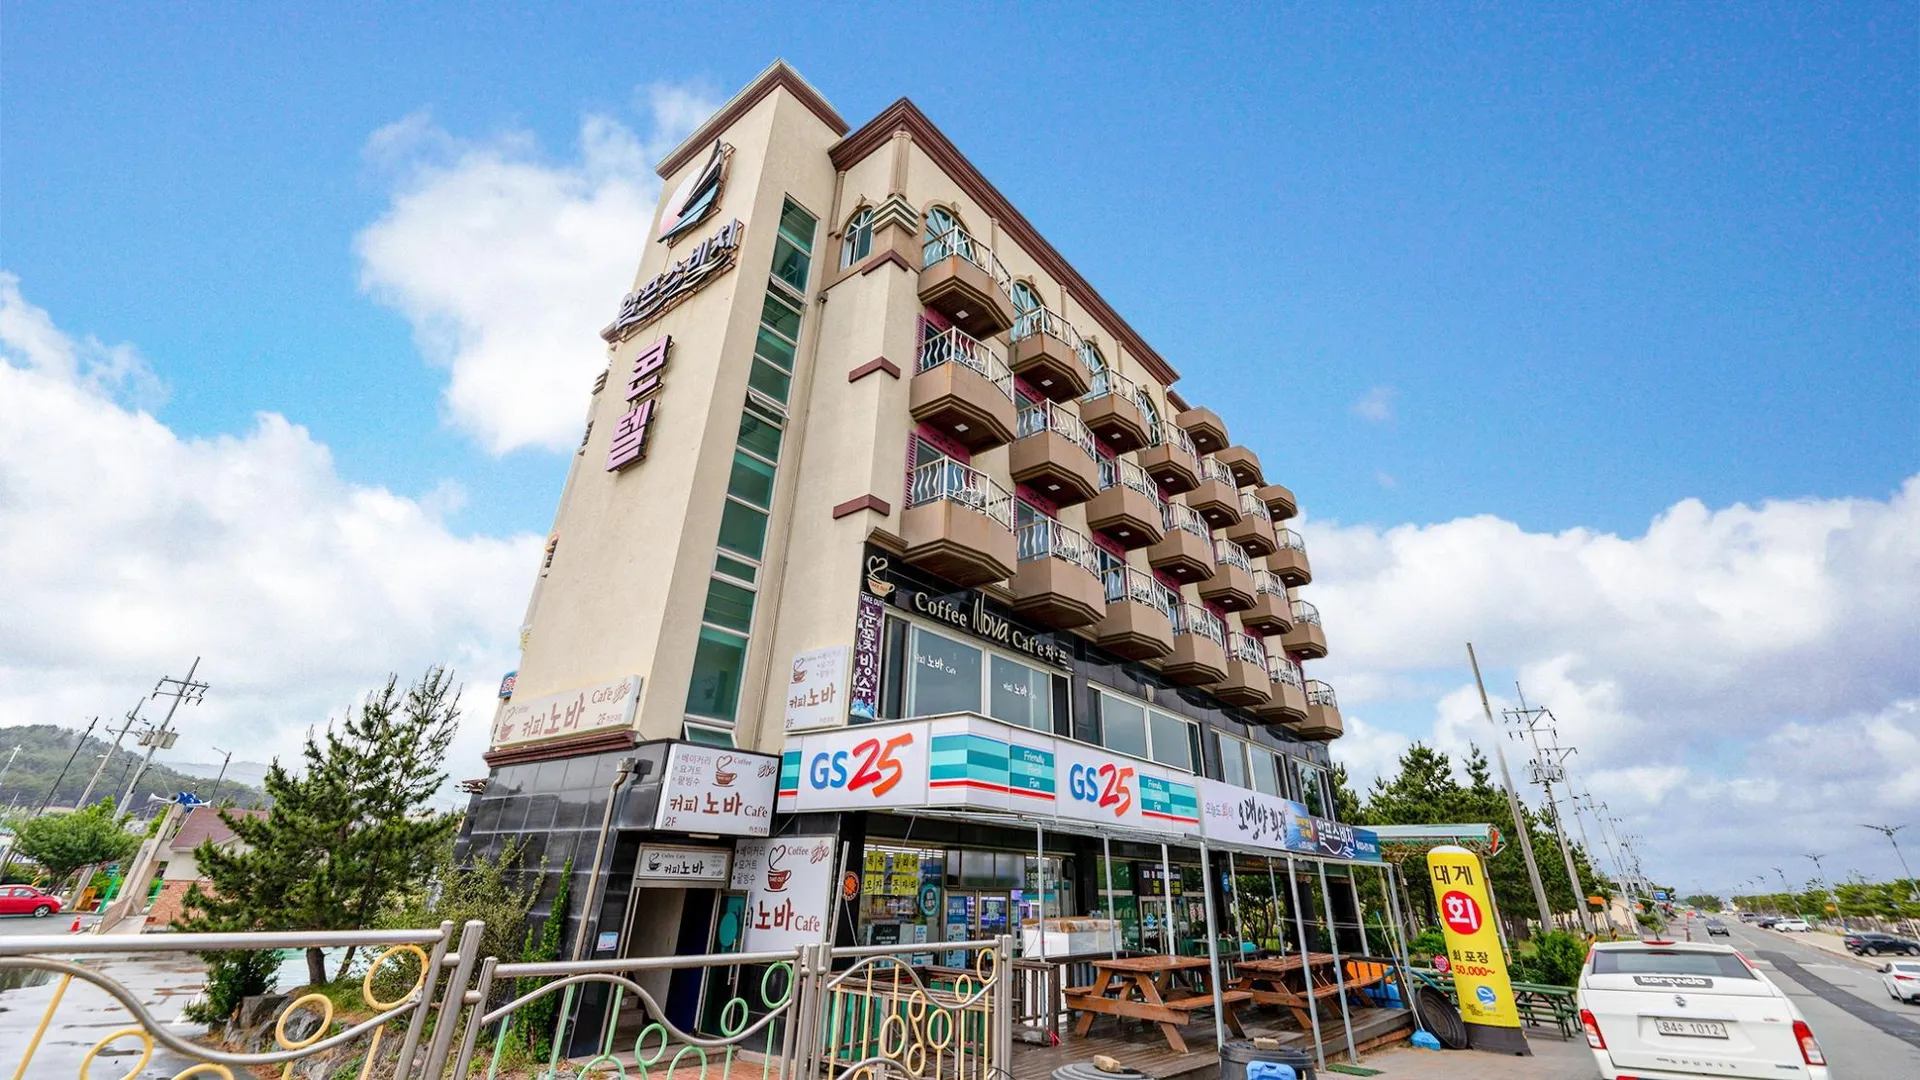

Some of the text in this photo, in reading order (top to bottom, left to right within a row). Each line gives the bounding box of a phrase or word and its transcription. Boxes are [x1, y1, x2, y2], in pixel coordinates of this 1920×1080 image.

[618, 218, 737, 326] 알프스비치
[605, 334, 672, 472] 콘텔
[861, 594, 873, 604] TAKE
[914, 591, 967, 627] Coffee
[972, 592, 1010, 643] Nova
[789, 682, 836, 708] 커피 노바
[522, 692, 585, 737] 커피 노바
[597, 713, 607, 725] 2F
[786, 719, 794, 728] 2F
[810, 732, 914, 798] GS25
[1070, 763, 1134, 817] GS25
[670, 794, 698, 813] 커피
[702, 792, 743, 816] 노바
[665, 816, 676, 827] 2F
[1316, 820, 1355, 847] 알프스비치
[787, 846, 809, 856] Coffee
[664, 864, 680, 874] 커피
[680, 860, 704, 875] 노바
[1433, 865, 1474, 886] 대게
[755, 897, 794, 931] 노바
[1446, 896, 1478, 930] 회
[1452, 949, 1489, 964] 회 포장
[1690, 1023, 1719, 1035] 1012
